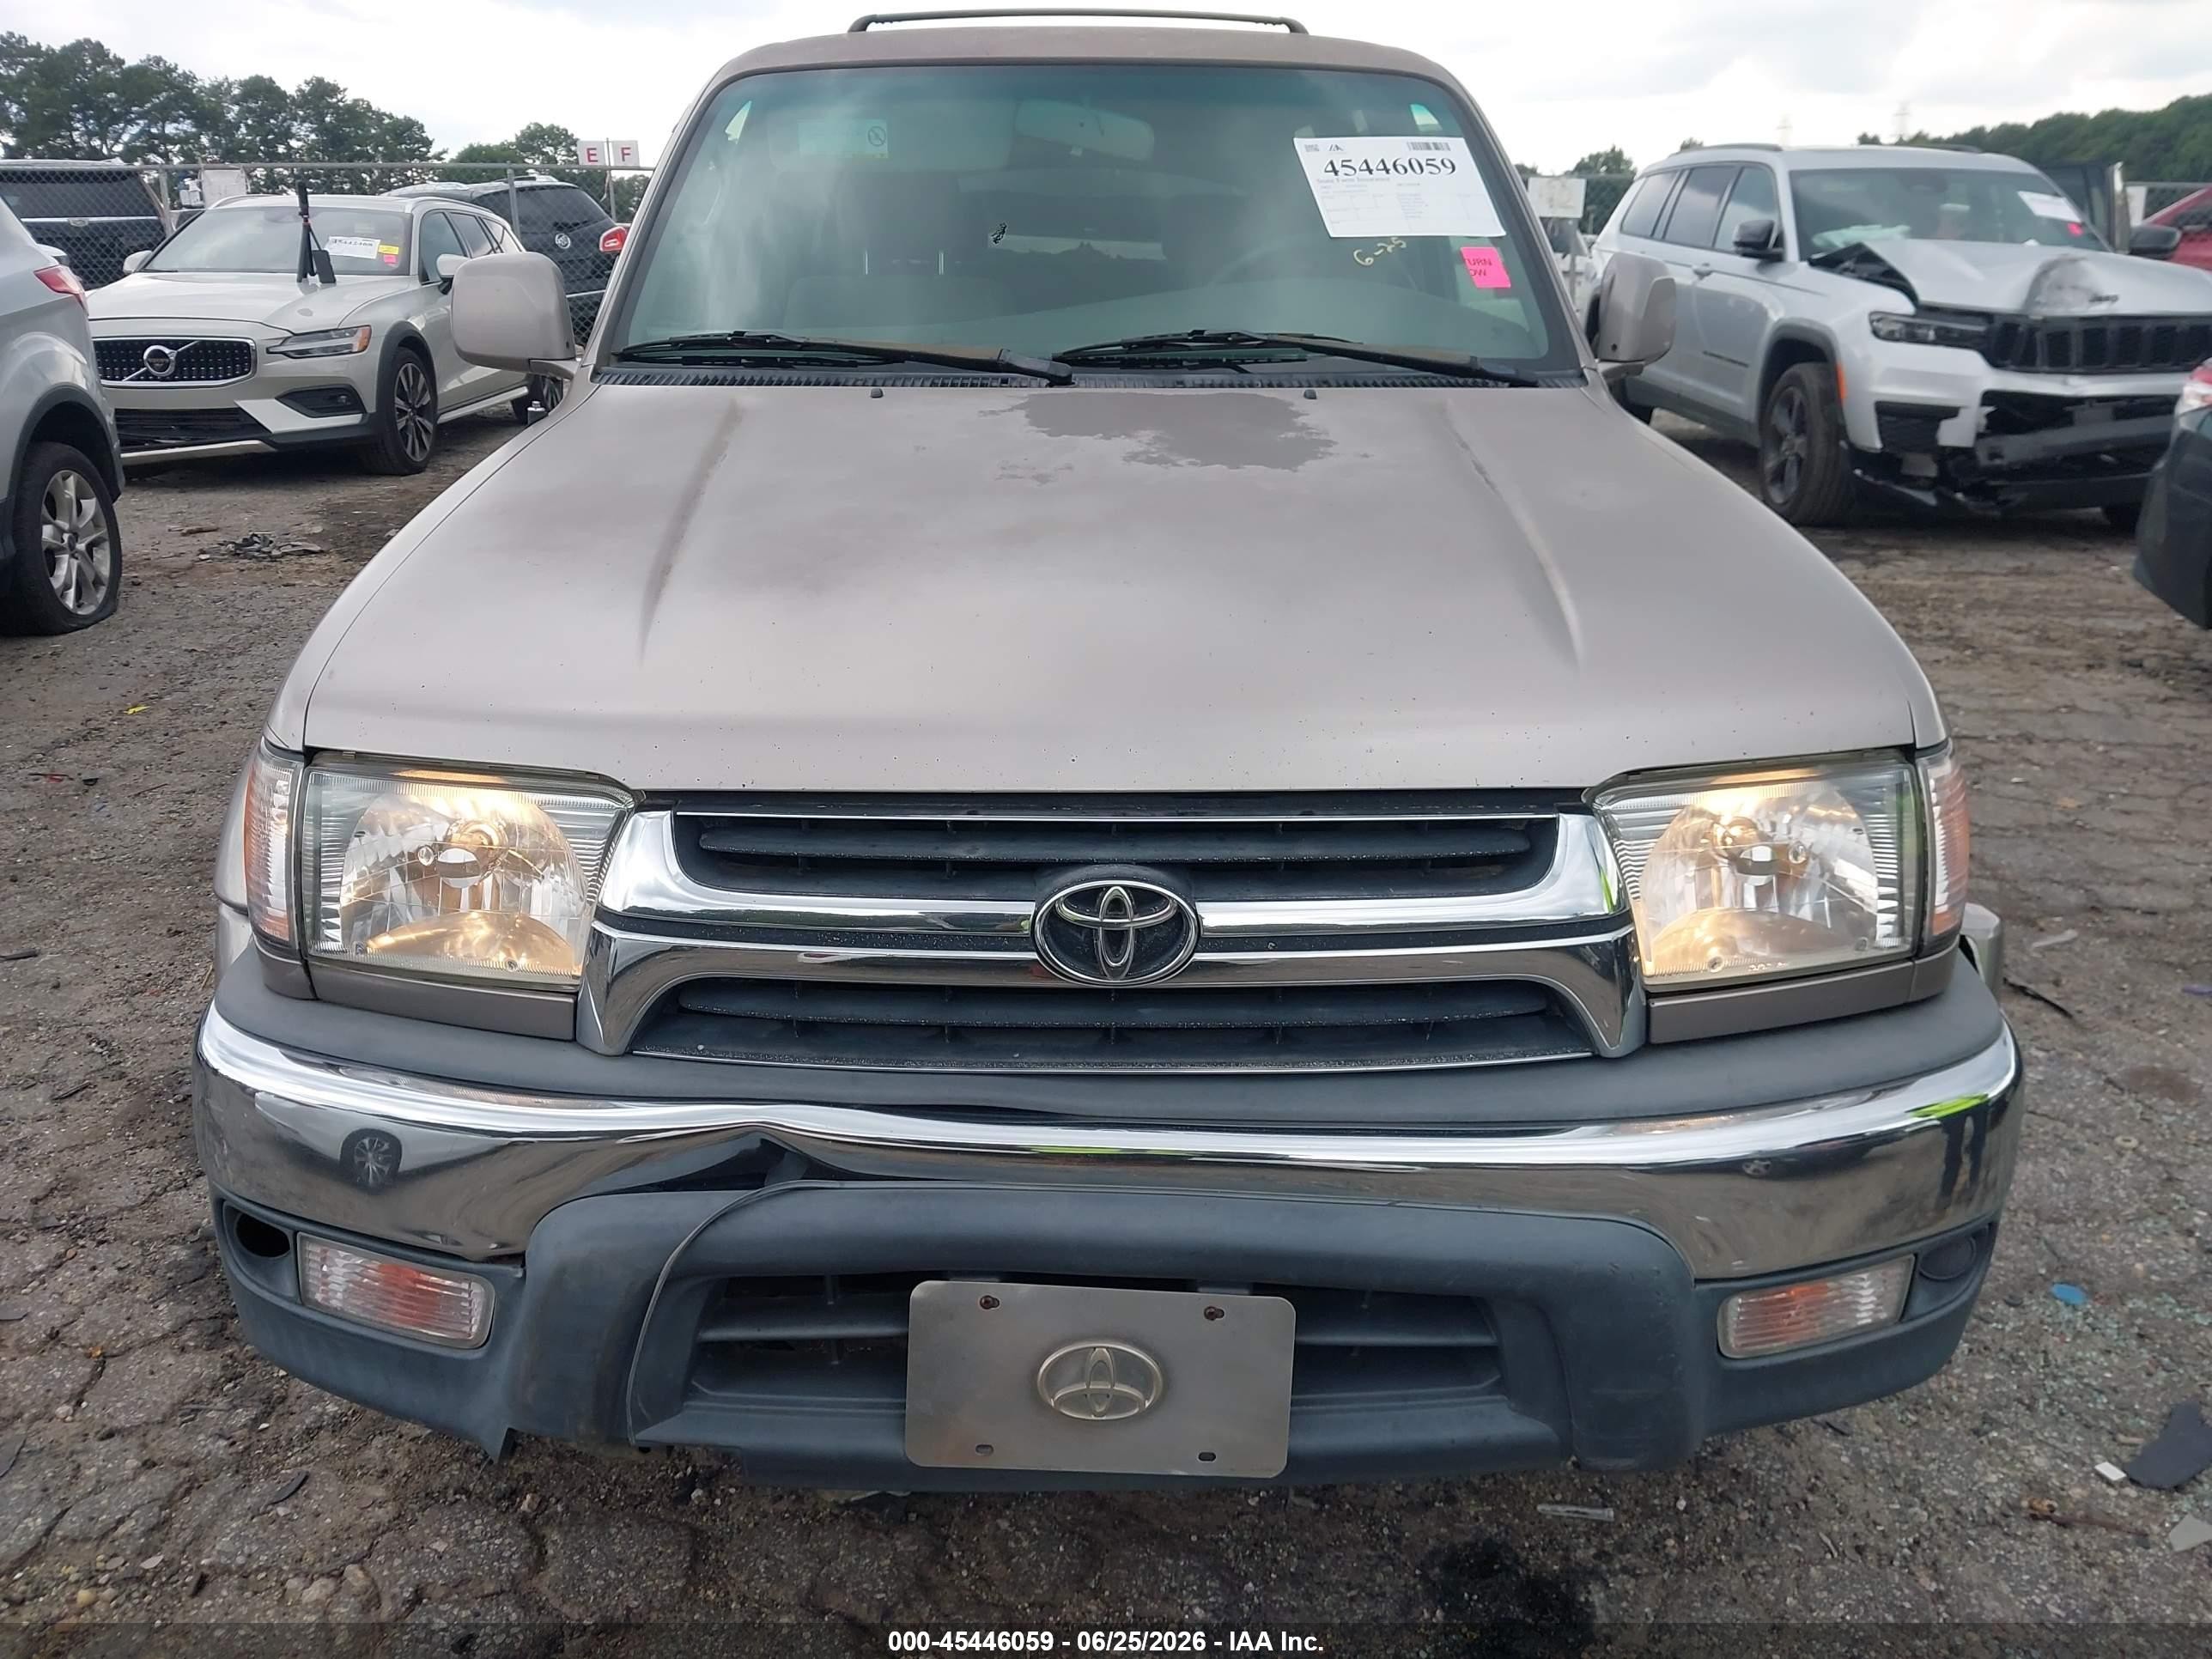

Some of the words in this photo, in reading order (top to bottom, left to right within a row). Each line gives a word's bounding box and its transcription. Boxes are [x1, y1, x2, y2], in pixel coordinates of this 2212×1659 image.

[586, 147, 599, 163] E
[621, 146, 631, 162] F
[1324, 157, 1456, 177] 45446059
